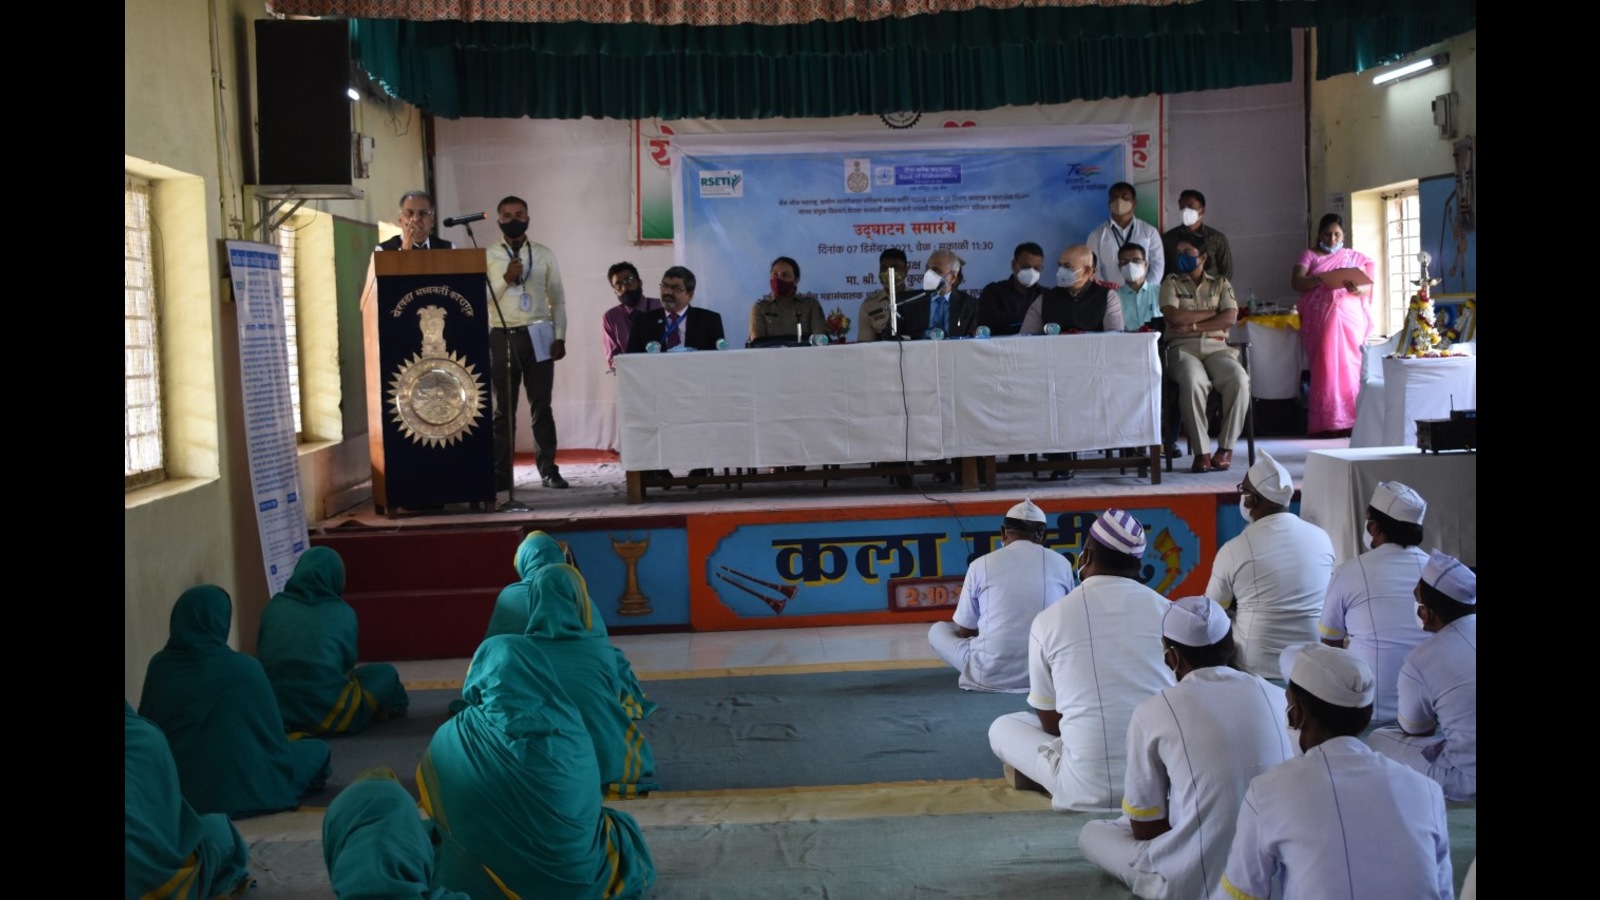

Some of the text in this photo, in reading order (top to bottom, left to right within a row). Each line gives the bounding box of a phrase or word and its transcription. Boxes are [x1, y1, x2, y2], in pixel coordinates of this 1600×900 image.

[854, 217, 956, 240] उद्घाटन समारंभ
[818, 243, 844, 255] दिनांक
[847, 245, 858, 254] 07
[916, 241, 931, 252] वेळ
[939, 239, 969, 251] सकाळी
[971, 241, 993, 251] 11:30
[772, 532, 948, 586] कला
